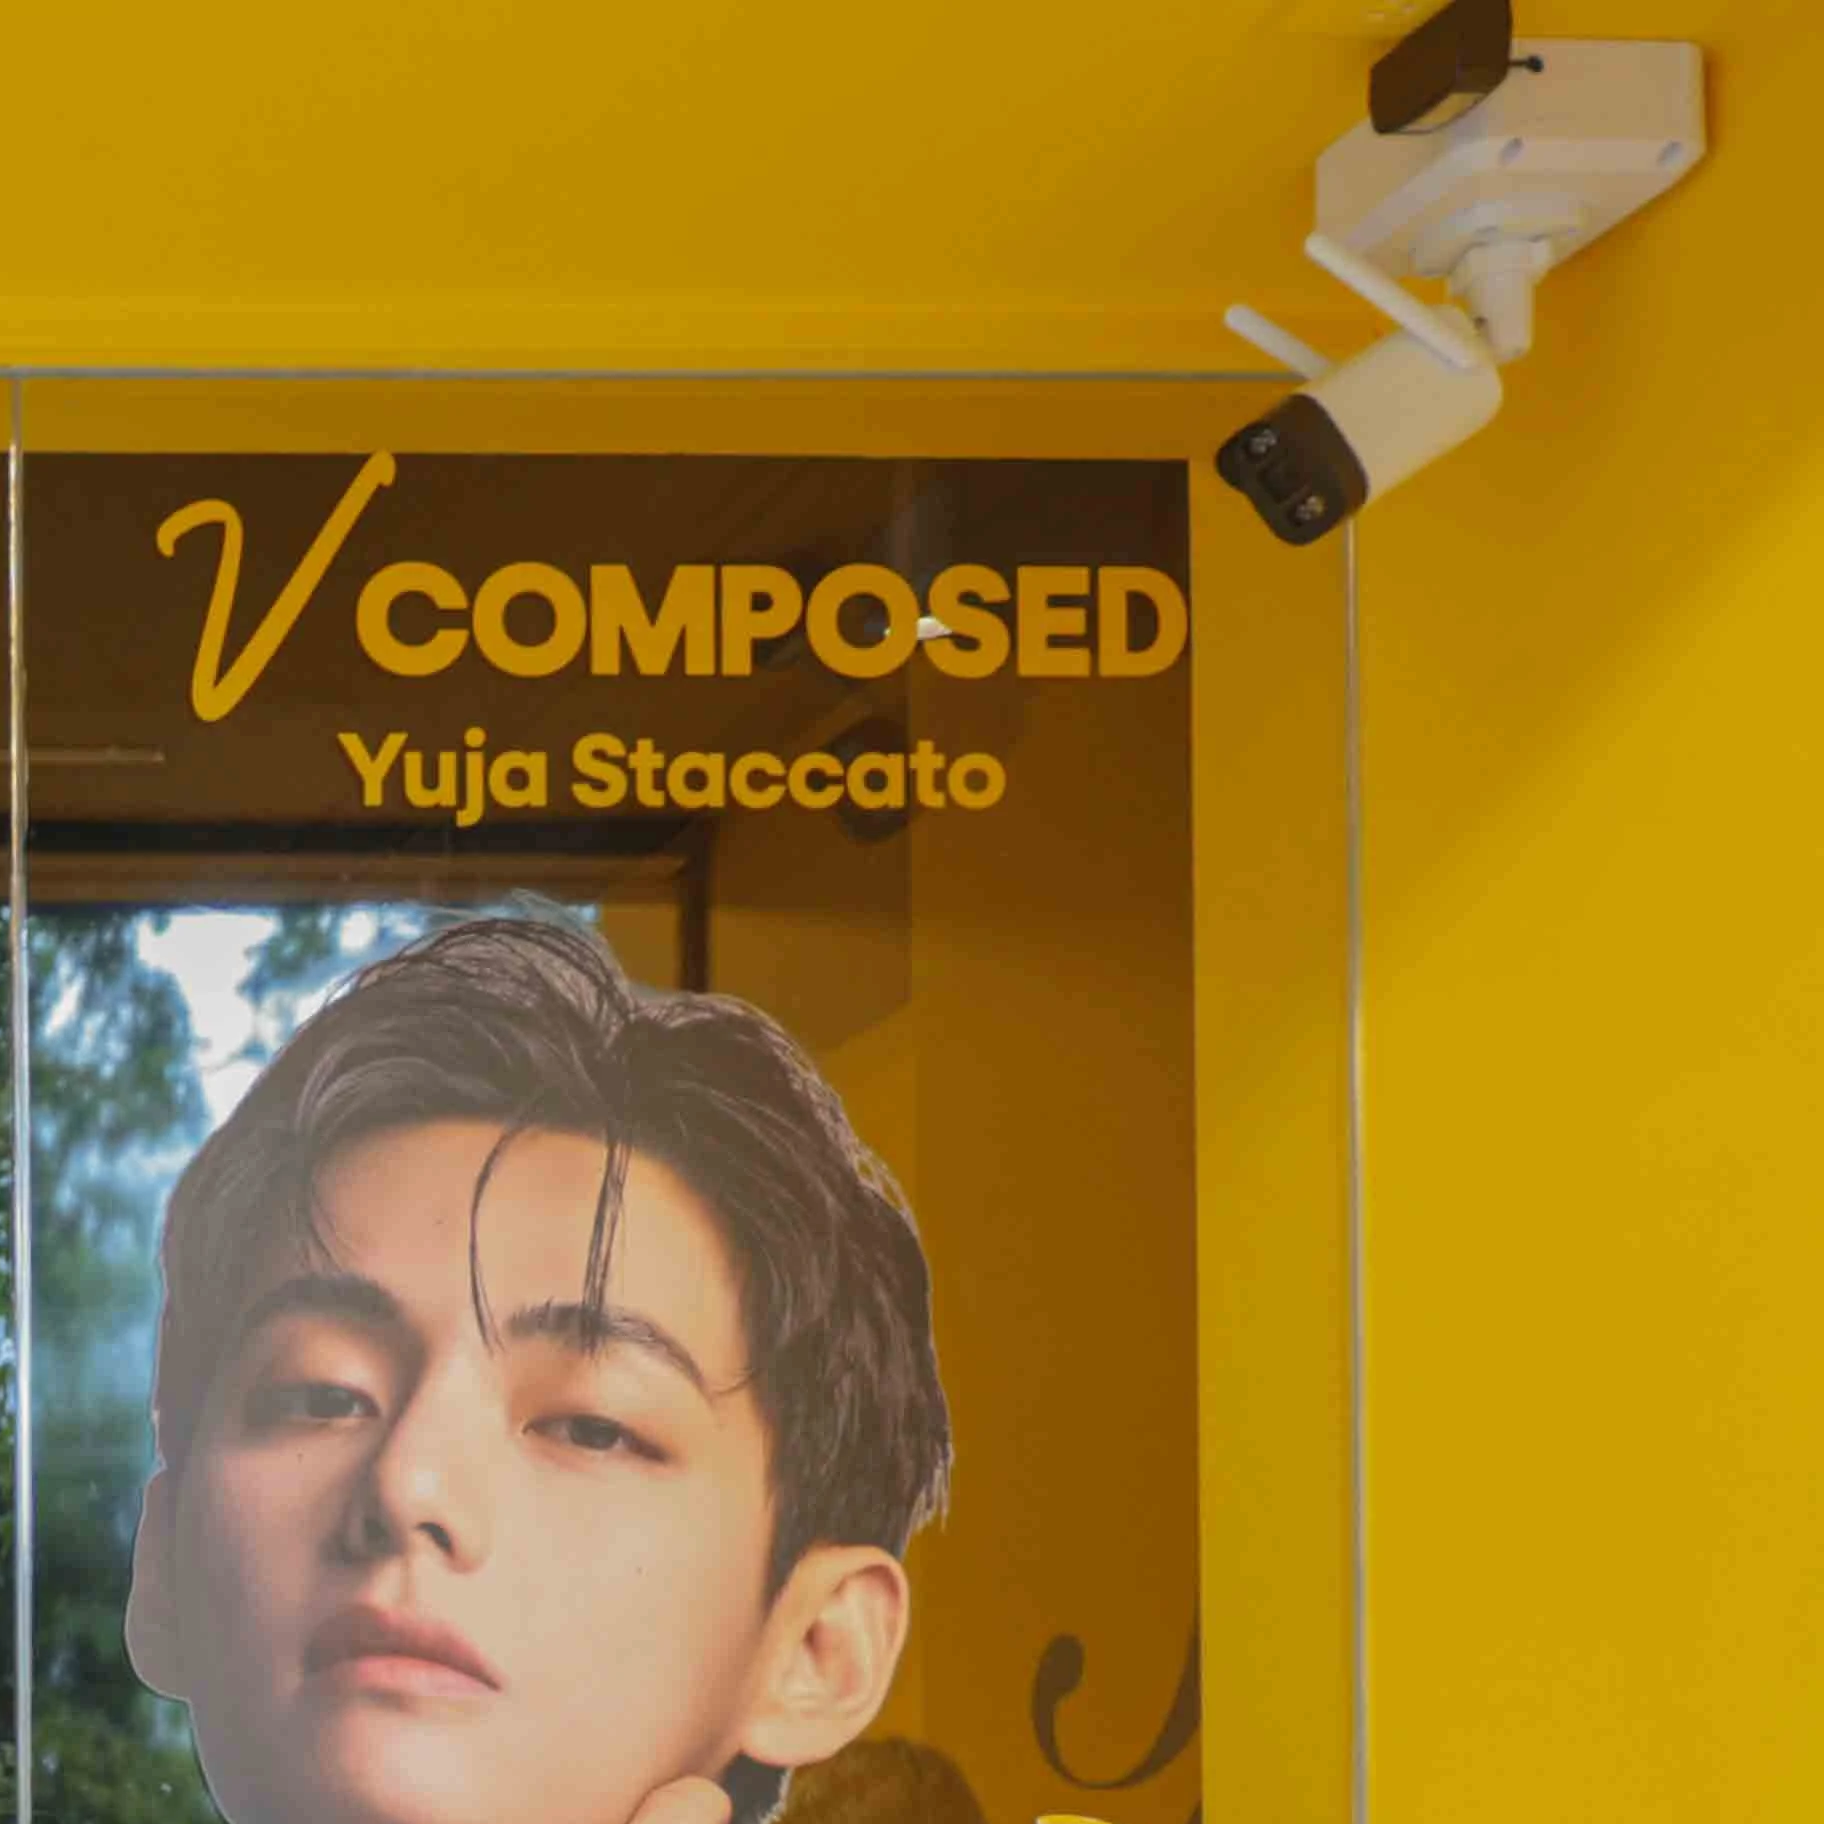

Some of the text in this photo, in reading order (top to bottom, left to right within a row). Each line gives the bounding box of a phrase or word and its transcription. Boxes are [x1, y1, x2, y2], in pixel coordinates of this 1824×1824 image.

[156, 450, 1189, 722] V COMPOSED
[337, 728, 1007, 827] Yuja Staccato
